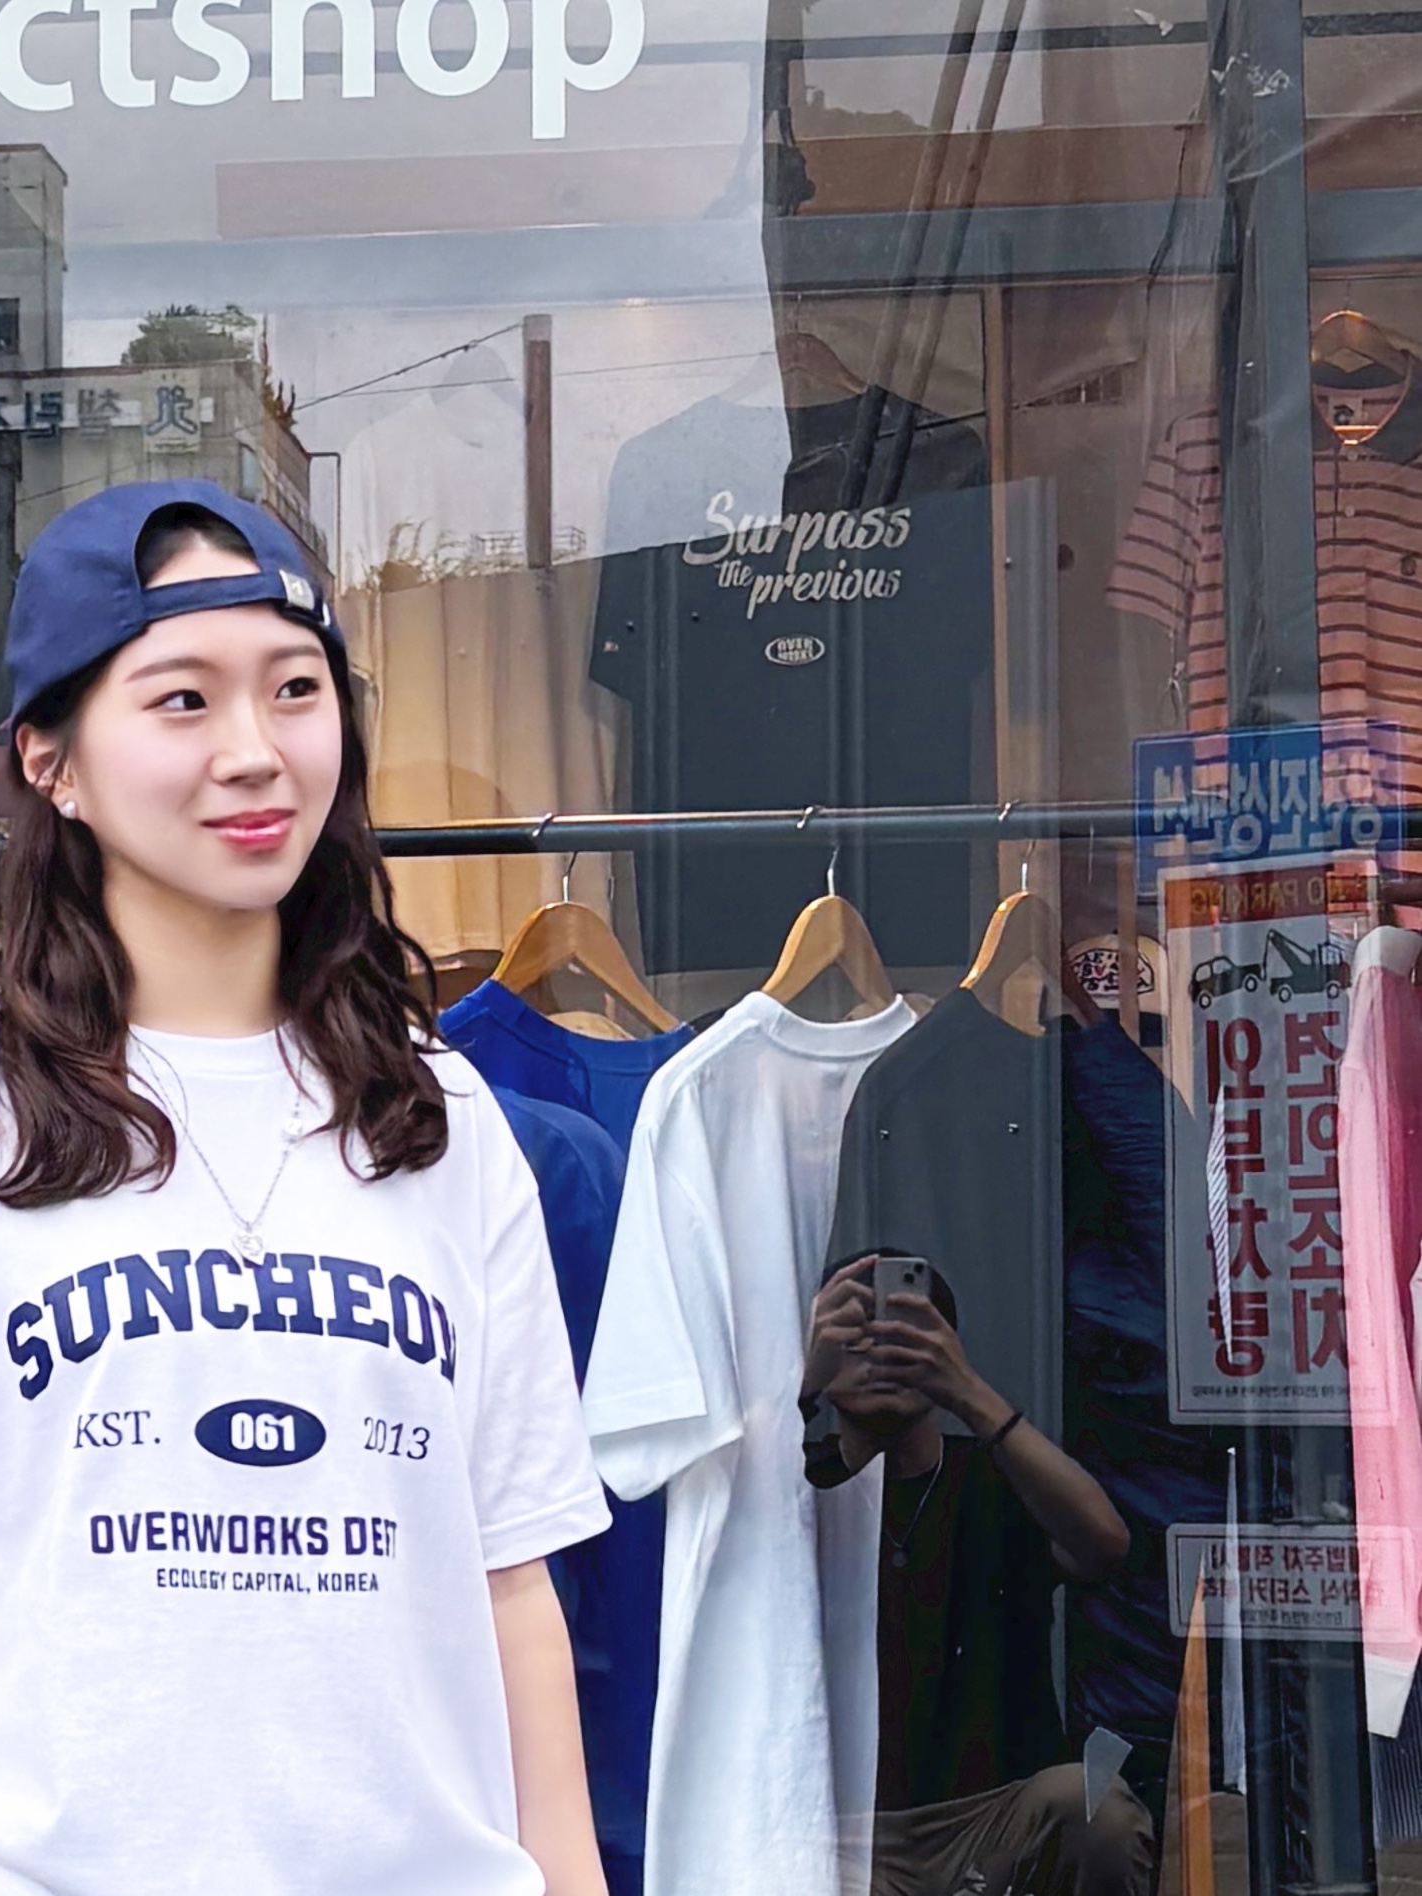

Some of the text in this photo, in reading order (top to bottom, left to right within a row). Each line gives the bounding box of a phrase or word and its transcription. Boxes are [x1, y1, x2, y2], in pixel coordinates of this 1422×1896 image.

[682, 490, 911, 574] Surpass
[714, 558, 902, 620] the previous
[230, 1411, 297, 1452] 061
[363, 1415, 431, 1461] 2013
[89, 1510, 329, 1557] OVERWORKS
[317, 1572, 380, 1593] KOREA
